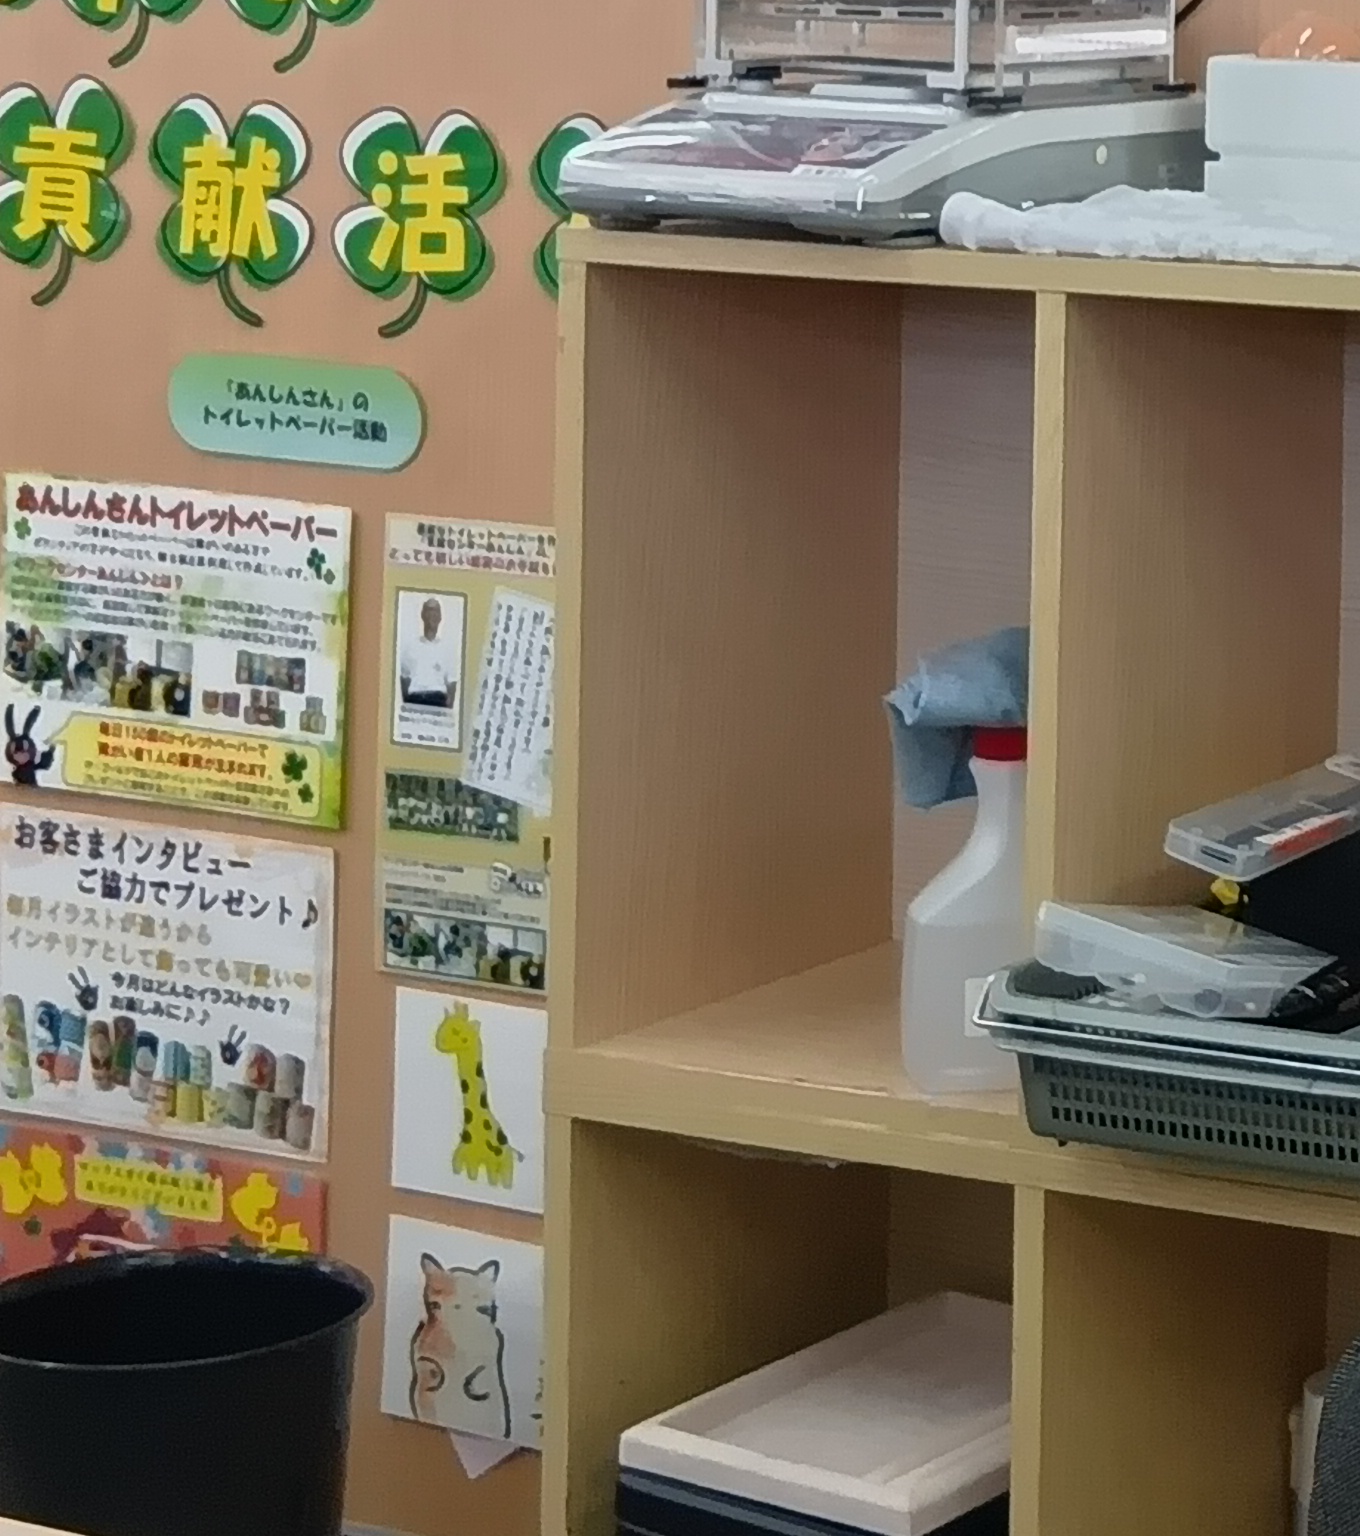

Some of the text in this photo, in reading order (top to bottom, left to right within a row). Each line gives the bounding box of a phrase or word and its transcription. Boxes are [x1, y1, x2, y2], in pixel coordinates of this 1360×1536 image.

[16, 481, 338, 542] あんしんさんトイレットペーパー
[14, 816, 252, 875] お客さまインタビュー
